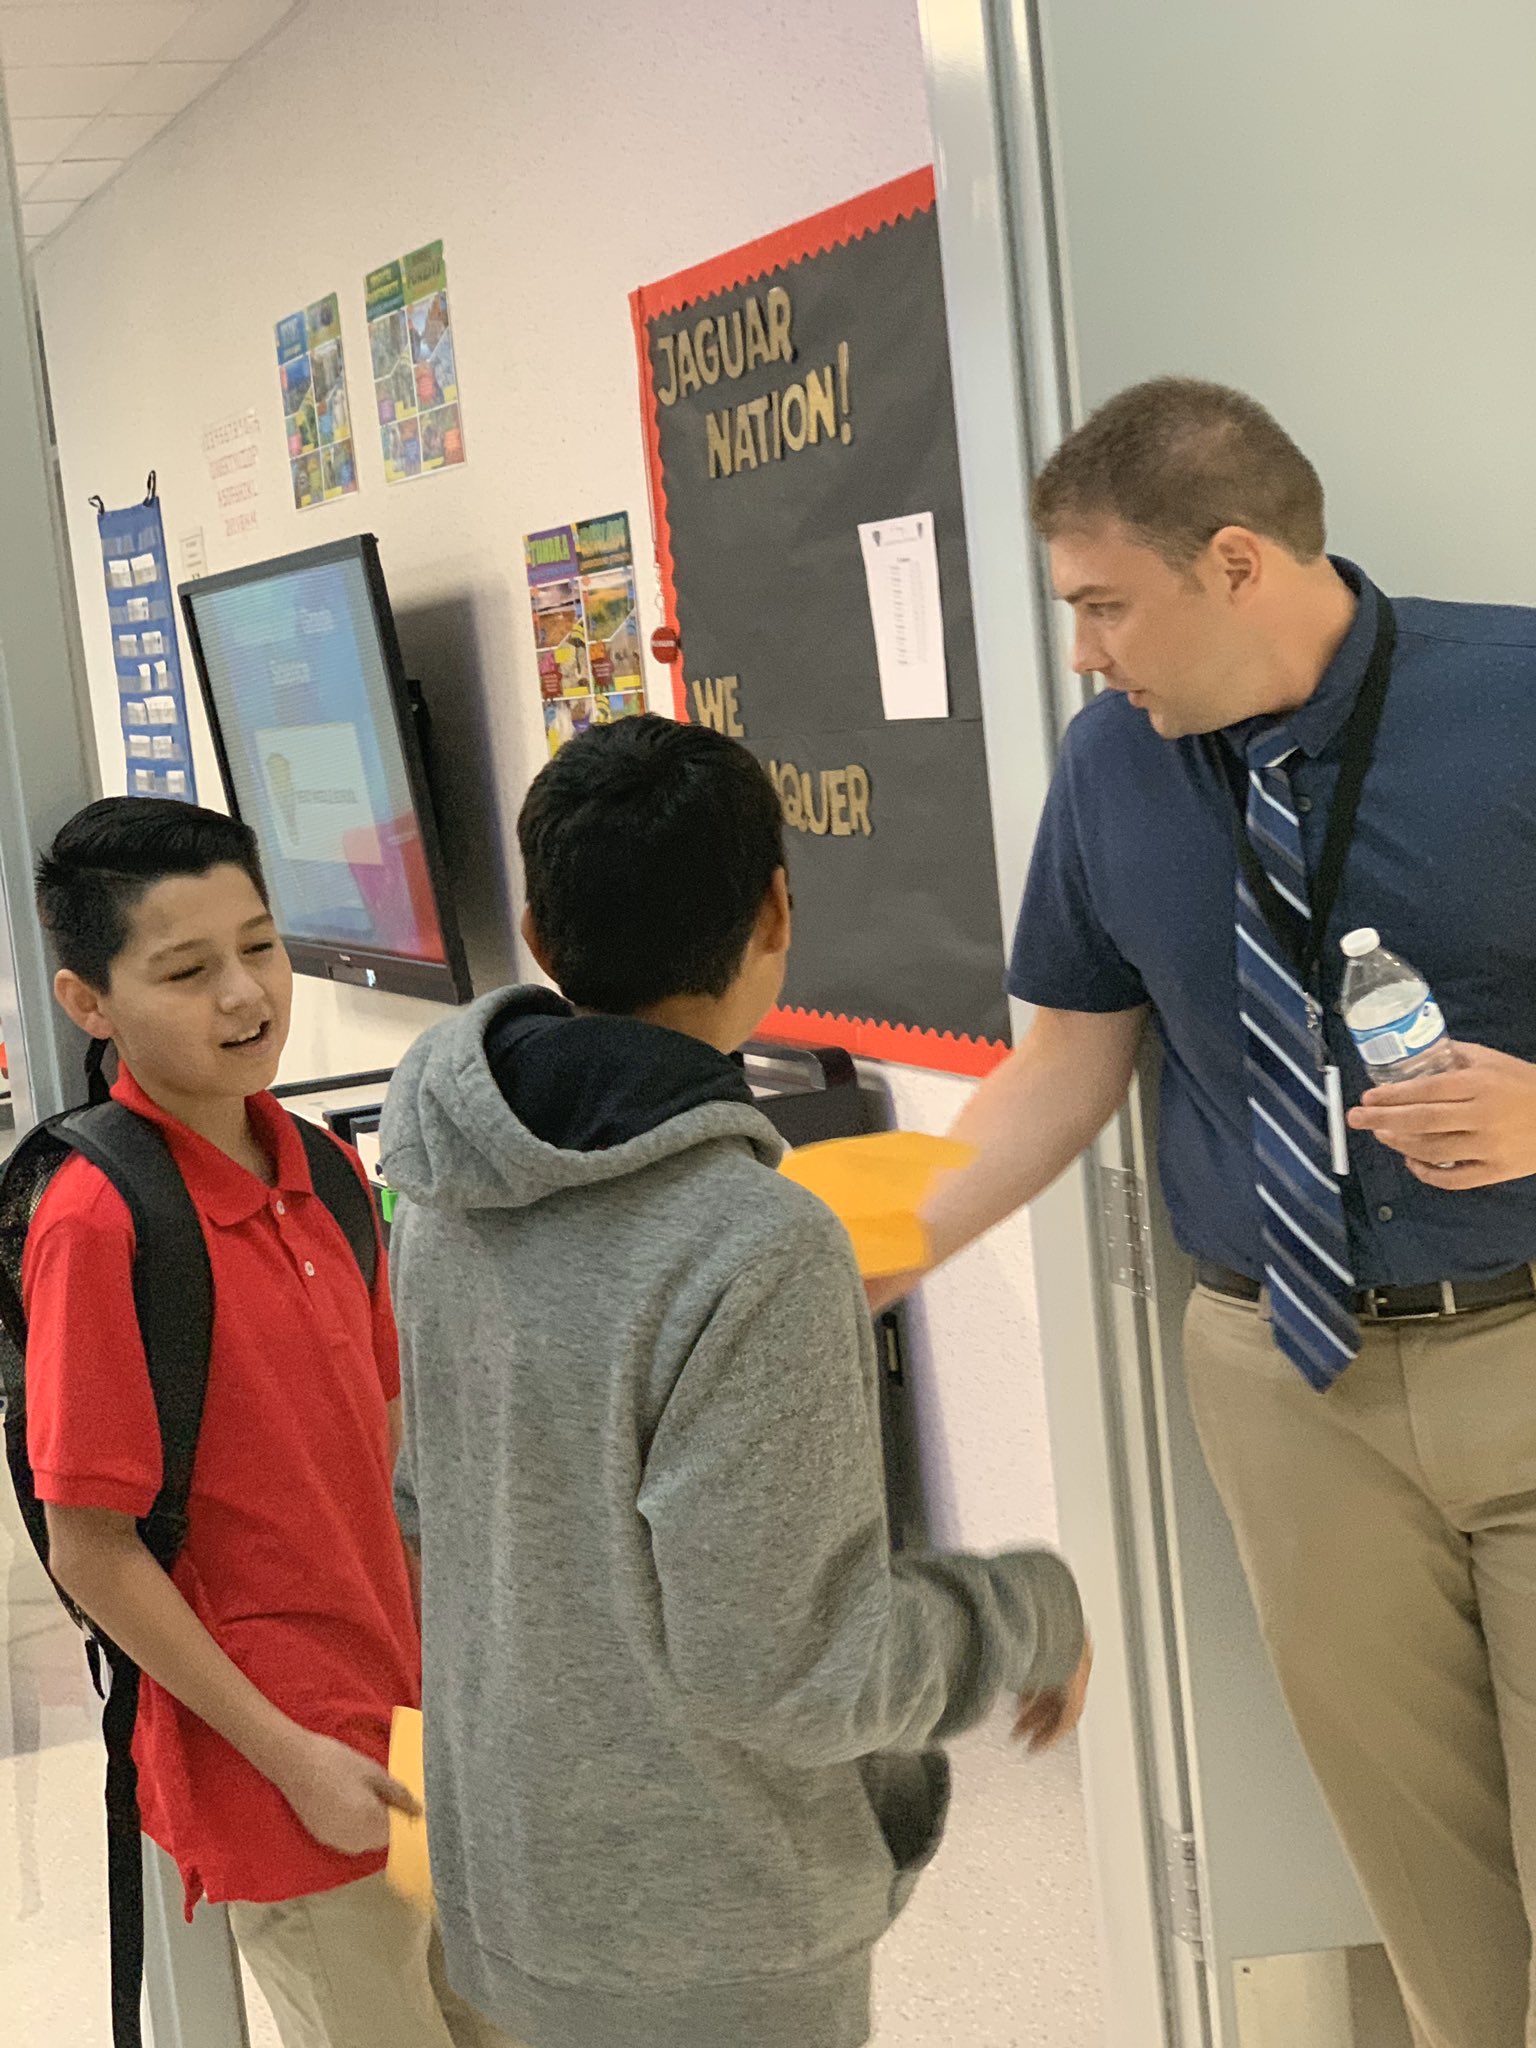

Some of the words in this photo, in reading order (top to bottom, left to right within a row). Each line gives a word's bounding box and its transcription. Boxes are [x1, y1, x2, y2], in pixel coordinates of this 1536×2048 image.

[657, 286, 793, 406] JAGUAR
[706, 341, 853, 478] NATION!
[692, 676, 744, 737] WE
